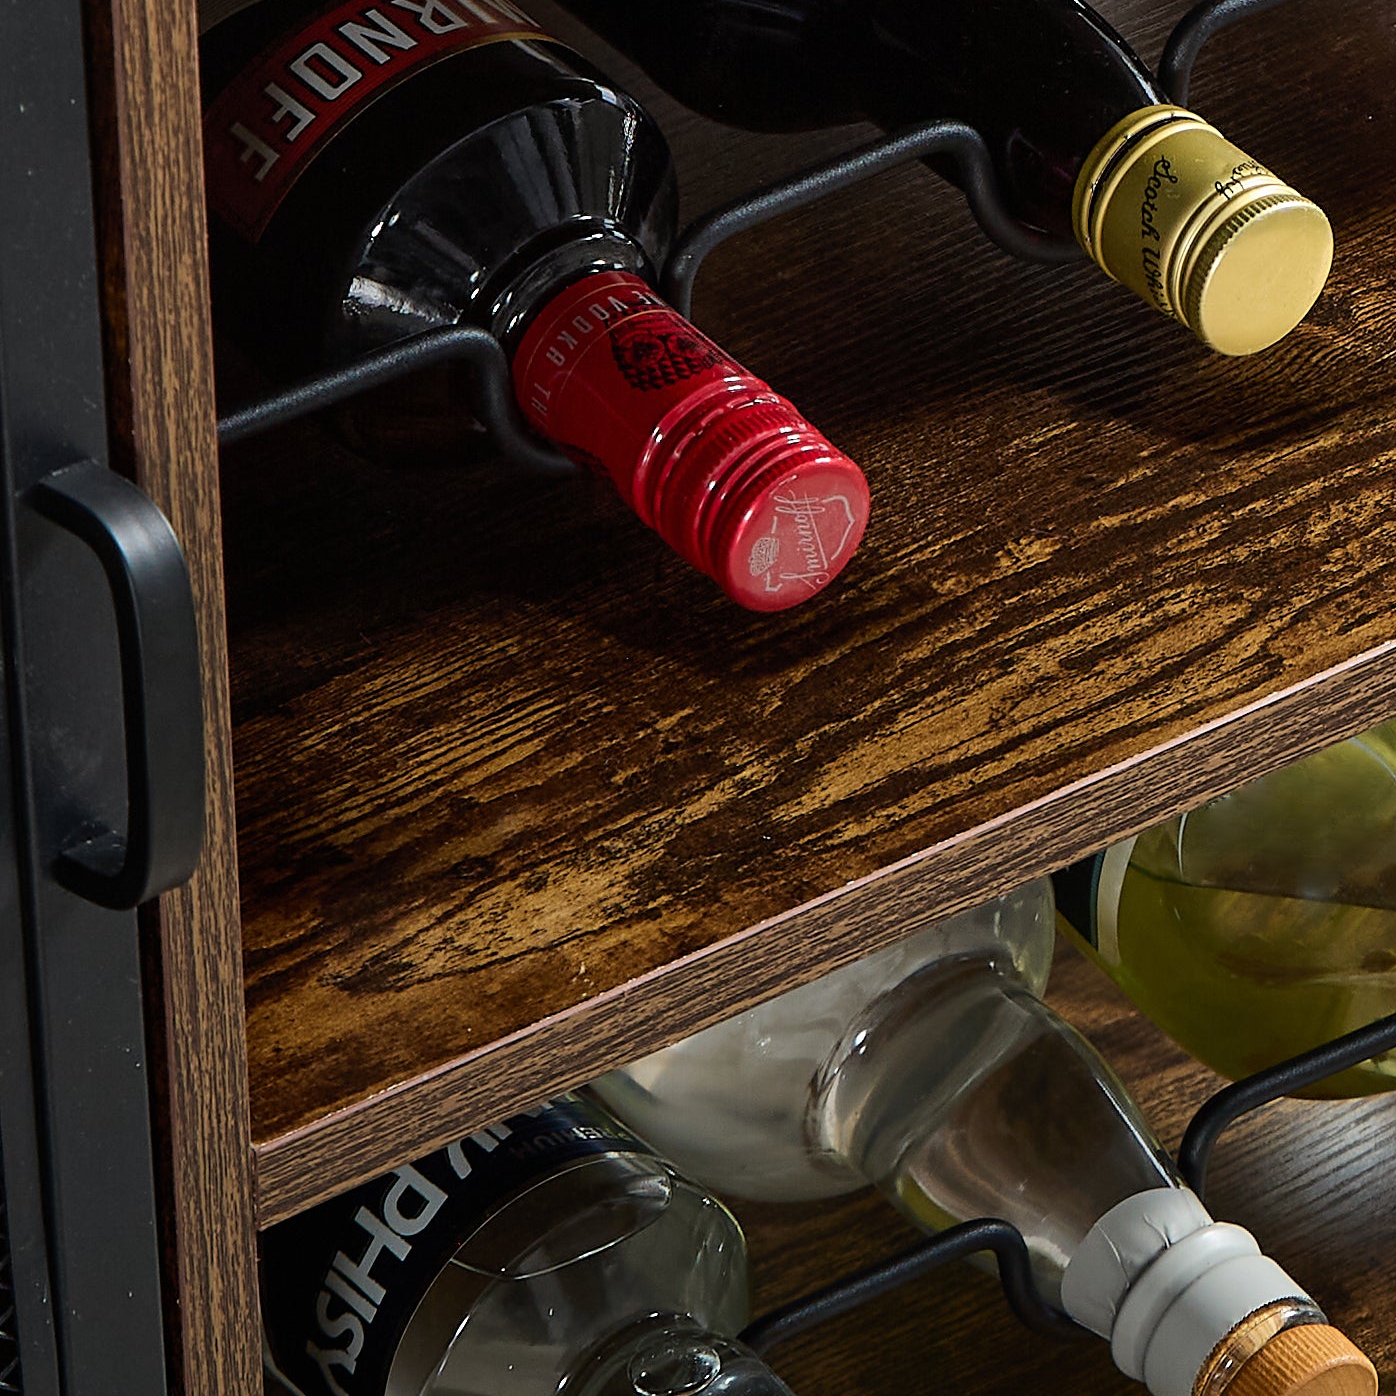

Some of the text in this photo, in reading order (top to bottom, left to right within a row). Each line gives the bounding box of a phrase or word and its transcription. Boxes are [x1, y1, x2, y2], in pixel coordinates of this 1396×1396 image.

[1141, 154, 1179, 242] Scotch
[545, 295, 629, 368] VODKA
[773, 489, 830, 591] Smirnoff
